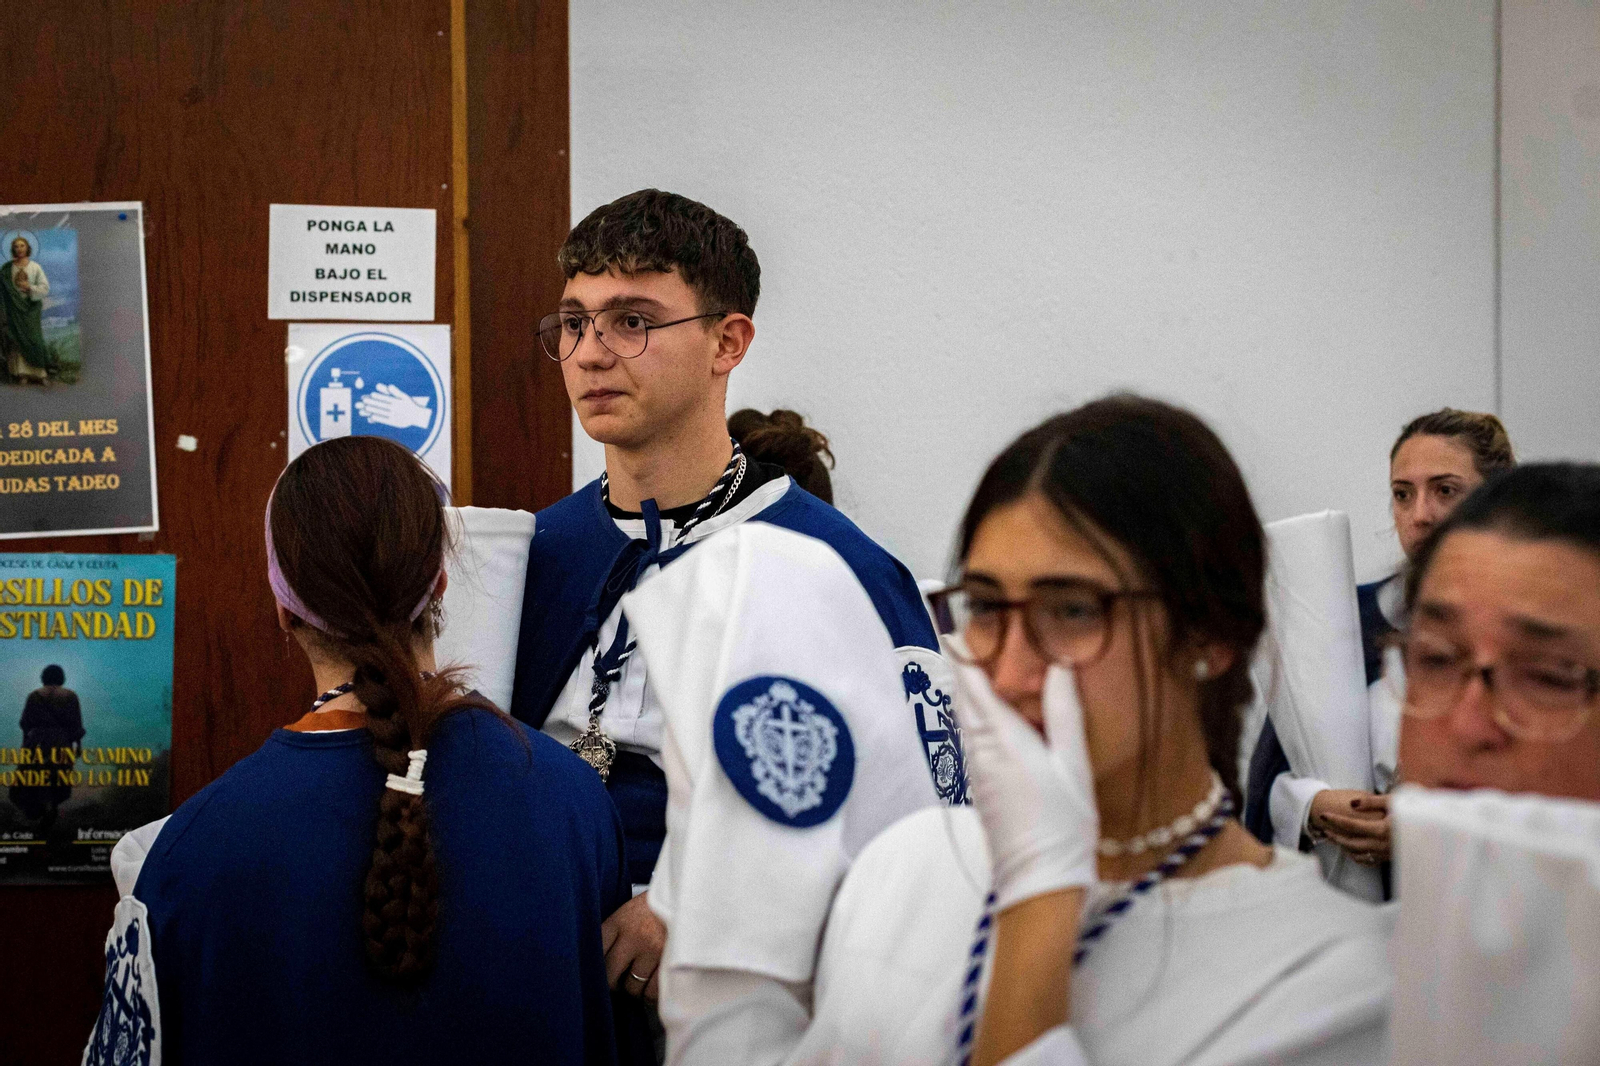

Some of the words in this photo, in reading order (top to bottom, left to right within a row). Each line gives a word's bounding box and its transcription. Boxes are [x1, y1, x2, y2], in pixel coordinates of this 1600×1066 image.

[307, 220, 367, 232] PONGA
[373, 221, 394, 232] LA
[325, 243, 376, 255] MANO
[315, 268, 361, 280] BAJO
[367, 268, 387, 280] EL
[290, 290, 412, 303] DISPENSADOR
[8, 420, 33, 438] 28
[38, 421, 75, 437] DEL
[78, 419, 119, 436] MES
[0, 447, 96, 466] DEDICADA
[101, 446, 117, 462] A
[54, 474, 121, 492] TADEO
[123, 578, 163, 606] DE
[0, 611, 156, 639] STIANDAD
[51, 746, 77, 764] UN
[82, 747, 152, 764] CAMINO
[57, 769, 82, 787] NO
[88, 769, 112, 786] LO
[117, 769, 152, 786] HAY
